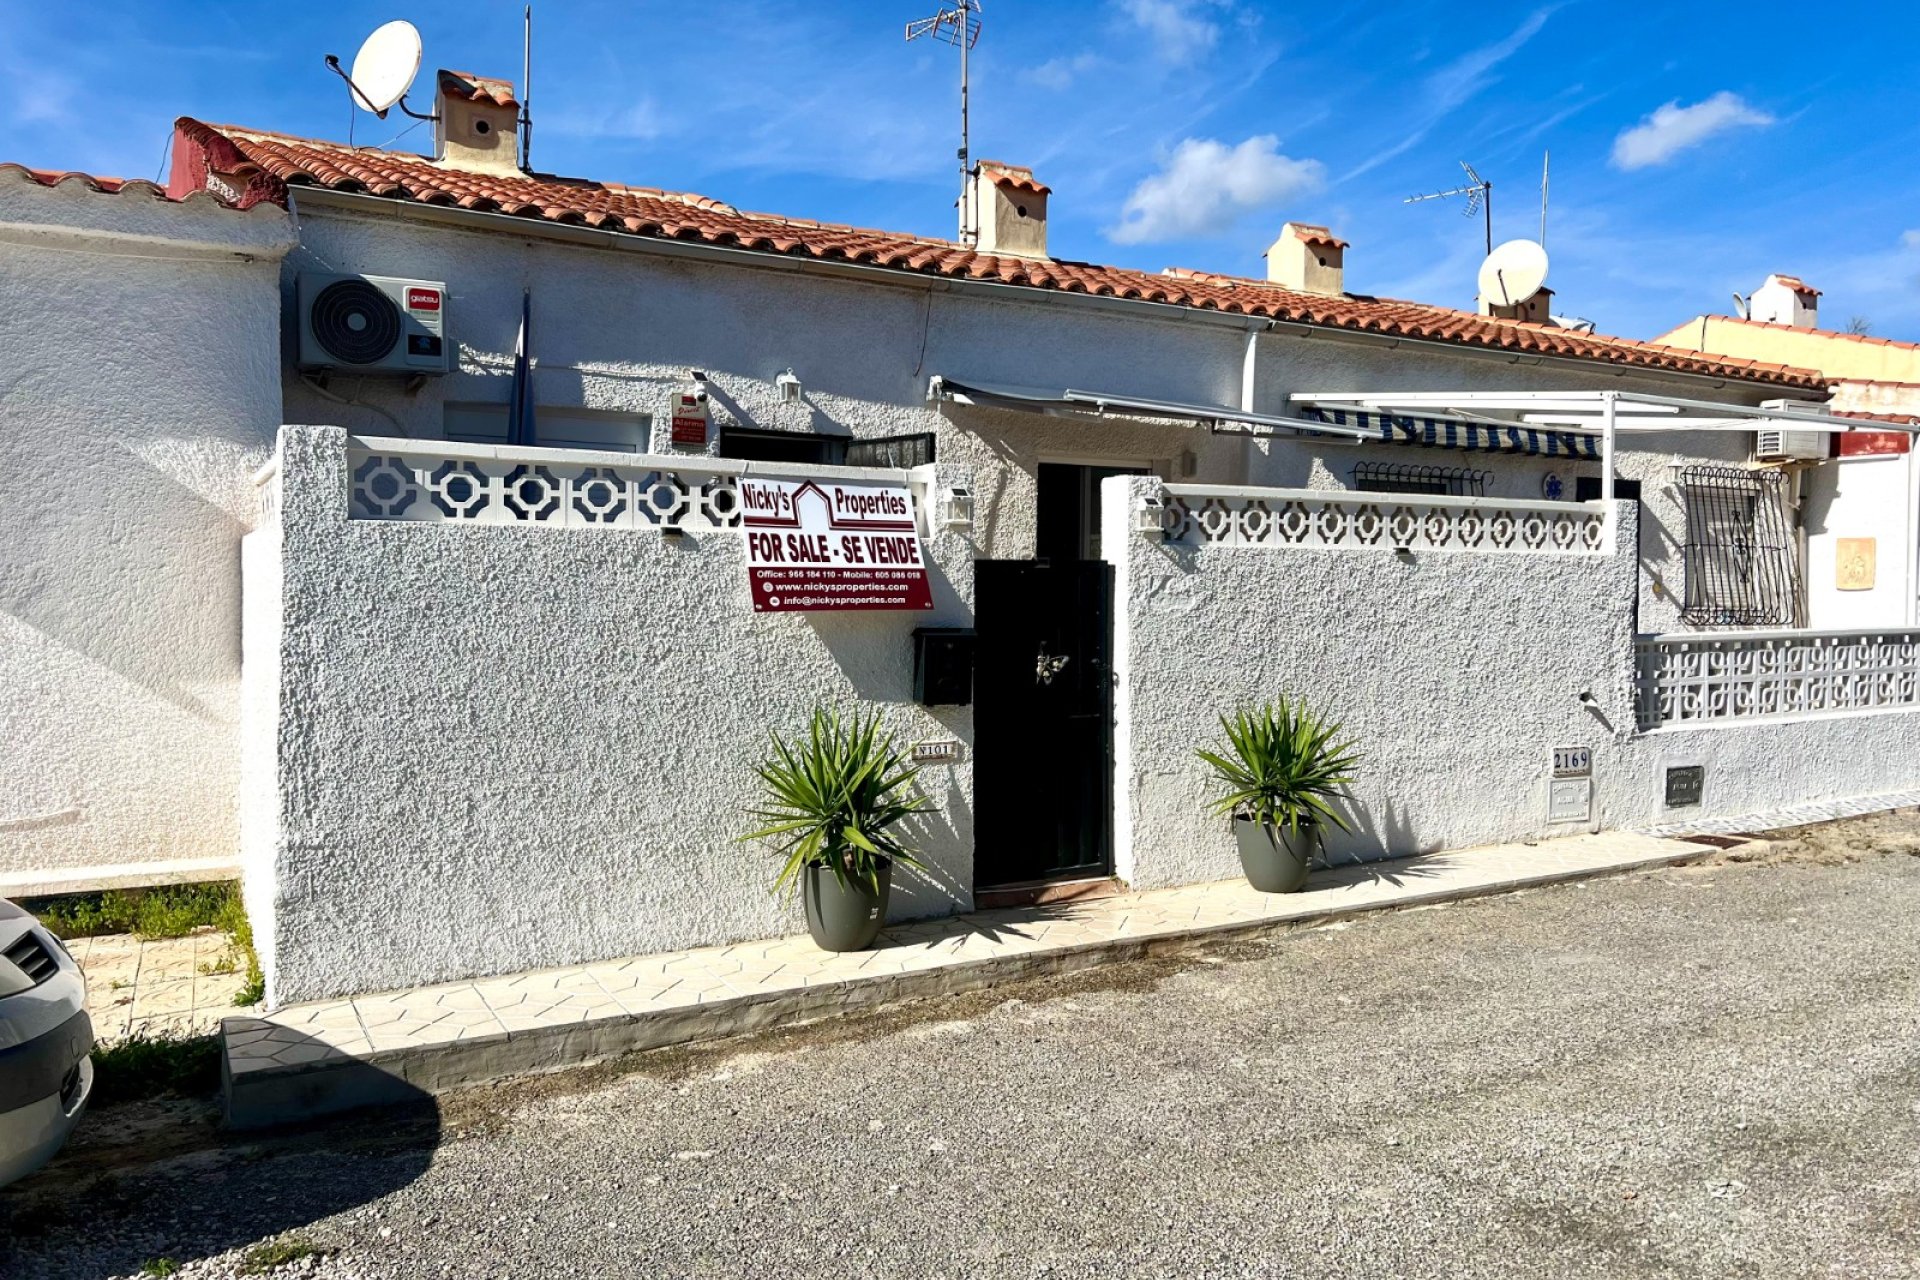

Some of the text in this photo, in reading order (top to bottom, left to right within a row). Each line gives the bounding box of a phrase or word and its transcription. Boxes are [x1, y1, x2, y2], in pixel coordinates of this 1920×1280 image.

[742, 483, 907, 520] Nicky's Properties
[748, 532, 785, 563] FOR
[787, 533, 831, 563] SALE
[841, 535, 867, 564] SE
[864, 536, 920, 564] VENDE
[756, 570, 787, 578] Office:
[843, 571, 873, 579] Mobile:
[775, 582, 909, 593] www.nickysproperties.com
[784, 596, 906, 606] info@nickysproperties.com
[1554, 752, 1587, 768] 2169
